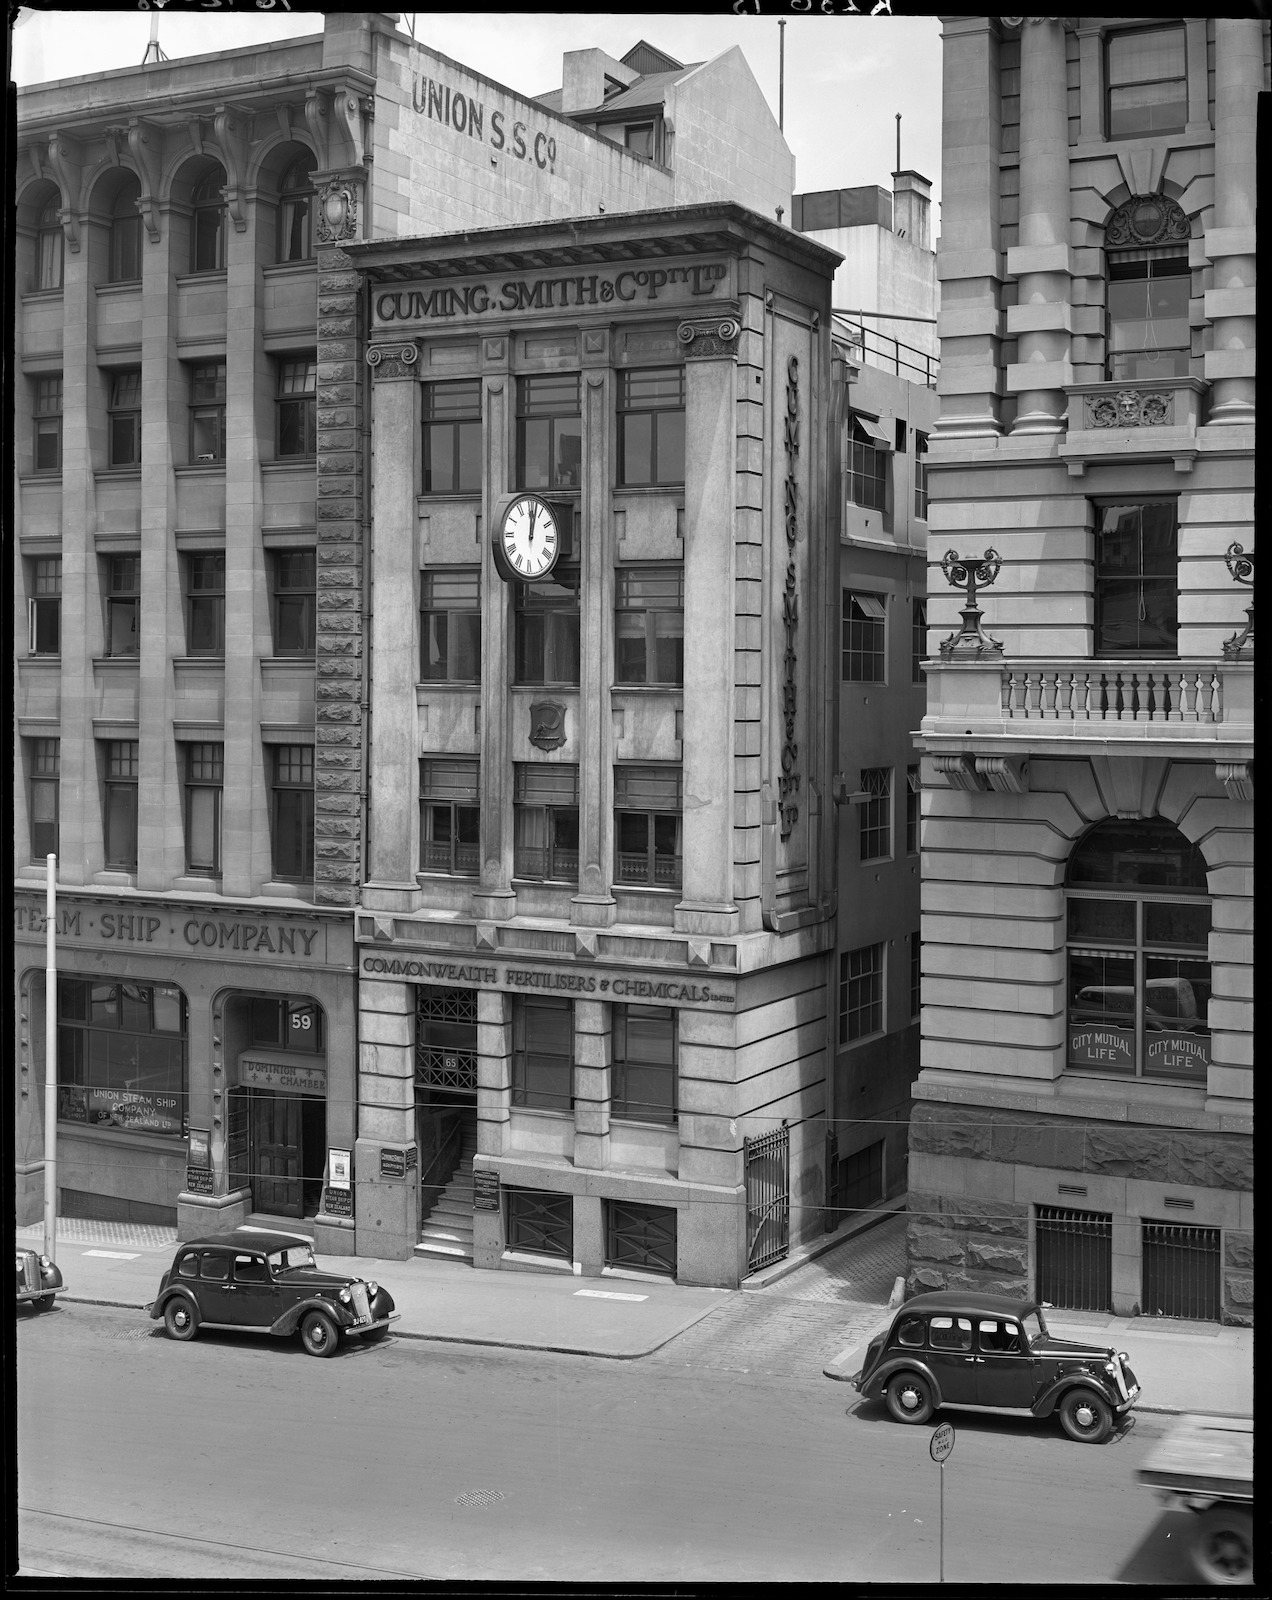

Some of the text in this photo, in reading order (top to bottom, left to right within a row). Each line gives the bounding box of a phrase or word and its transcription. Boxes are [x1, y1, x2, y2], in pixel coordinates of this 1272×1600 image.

[412, 71, 484, 141] UNION
[500, 275, 598, 311] SMITH
[600, 280, 614, 302] &
[100, 913, 161, 942] SHIP
[184, 920, 318, 956] COMPANY
[363, 957, 735, 1003] COMMONWEALTH FERTILISERS & CHEMICALS LIMITED
[292, 1013, 311, 1030] 59
[1072, 1032, 1132, 1057] CITY MUTUAL
[1148, 1040, 1208, 1064] CITY MUTUAL
[1087, 1047, 1117, 1060] LIFE
[1163, 1054, 1193, 1068] LIFE
[248, 1062, 296, 1076] DOMINION
[445, 1057, 457, 1068] 65
[280, 1076, 326, 1090] CHAMBER
[93, 1088, 119, 1100] UNION
[122, 1092, 152, 1105] STEAM
[156, 1098, 177, 1108] SHIP
[98, 1111, 108, 1119] OF
[125, 1115, 159, 1127] ZEALAND
[935, 1427, 951, 1441] SAFETY
[936, 1442, 950, 1454] ZONE
